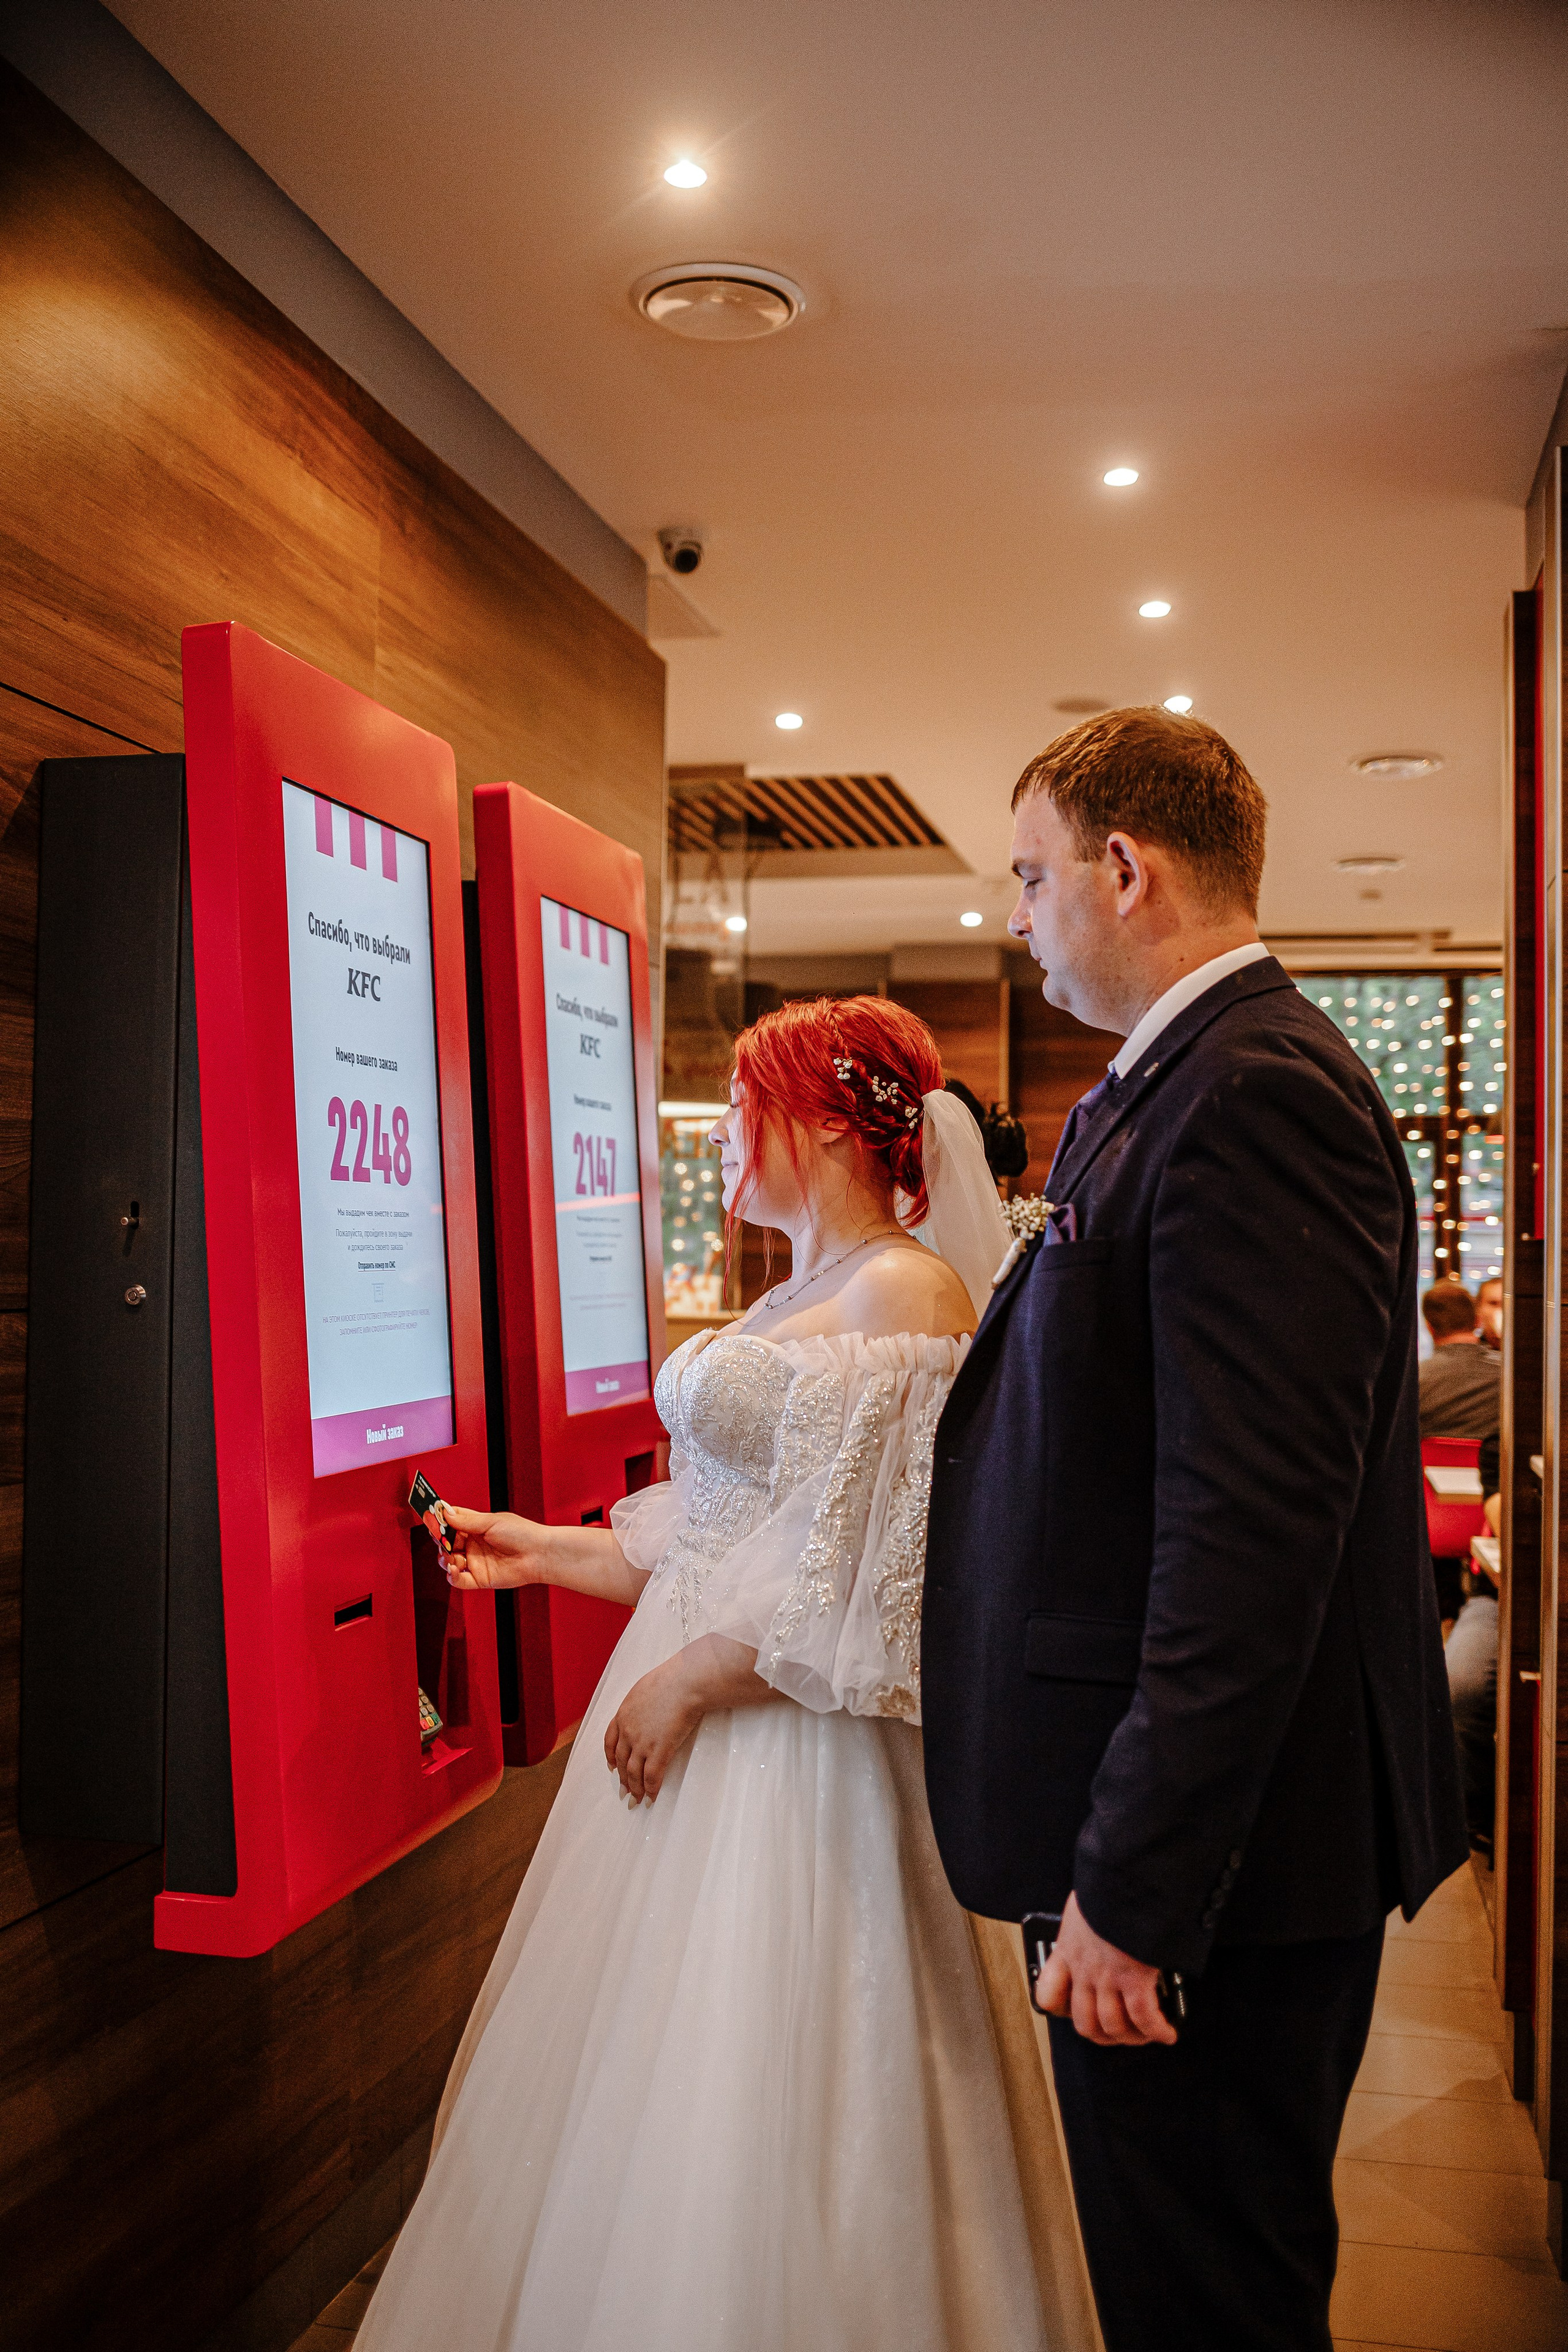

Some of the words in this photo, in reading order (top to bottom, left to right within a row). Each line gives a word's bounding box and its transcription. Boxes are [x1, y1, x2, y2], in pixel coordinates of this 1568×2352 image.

[307, 911, 352, 952] Спасибо,
[354, 931, 370, 952] что
[372, 934, 410, 965] выбрали
[347, 967, 381, 1002] KFC
[335, 1046, 355, 1067] Номер
[356, 1053, 378, 1068] вашего
[379, 1058, 398, 1072] заказа
[579, 1033, 601, 1059] KFC
[327, 1096, 412, 1186] 2248
[573, 1131, 616, 1197] 2147
[337, 1207, 345, 1216] Мы
[345, 1209, 365, 1218] выдадим
[335, 1228, 364, 1238] Пожалуйста,
[364, 1228, 384, 1238] пройдите
[366, 1423, 387, 1444] Новый
[387, 1425, 404, 1440] заказ
